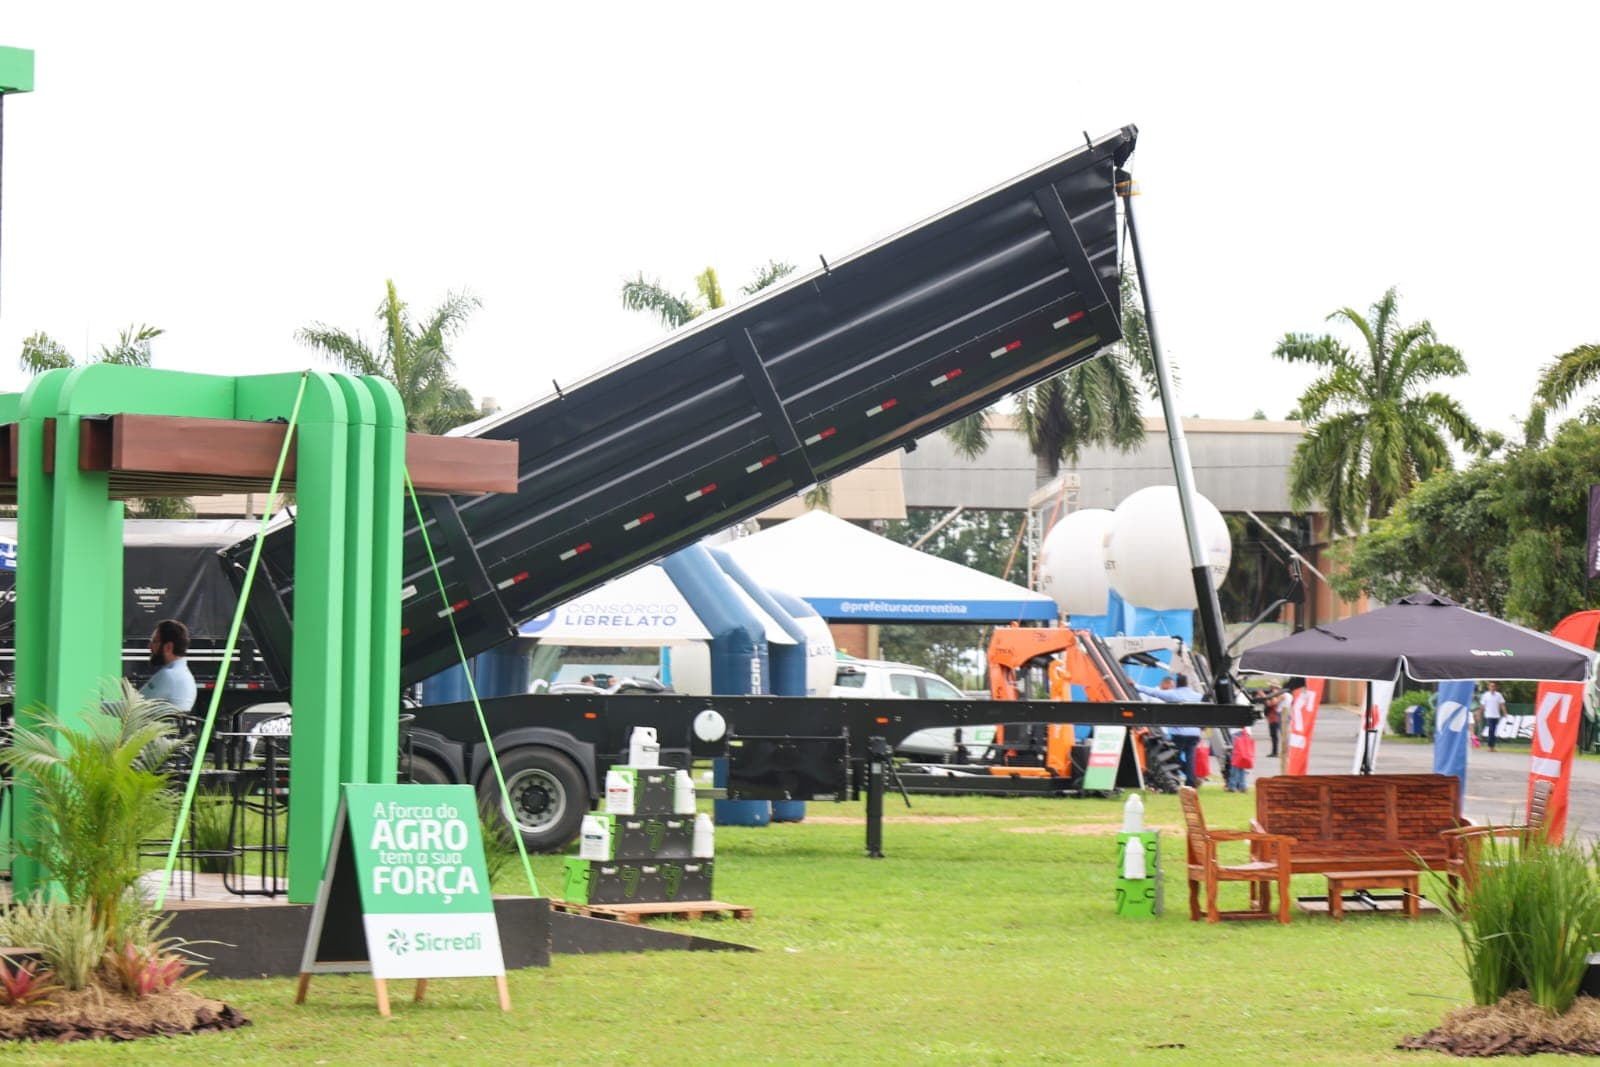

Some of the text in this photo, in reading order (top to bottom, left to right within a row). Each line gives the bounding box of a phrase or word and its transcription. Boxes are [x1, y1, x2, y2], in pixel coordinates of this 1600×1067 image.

[841, 601, 967, 614] @prefeituracorrentina
[565, 615, 677, 627] LIBRELATO
[373, 801, 459, 821] A força do
[370, 819, 469, 851] AGRO
[379, 850, 462, 864] tem a sua
[373, 865, 480, 904] FORÇA
[414, 932, 482, 951] Sicredi
